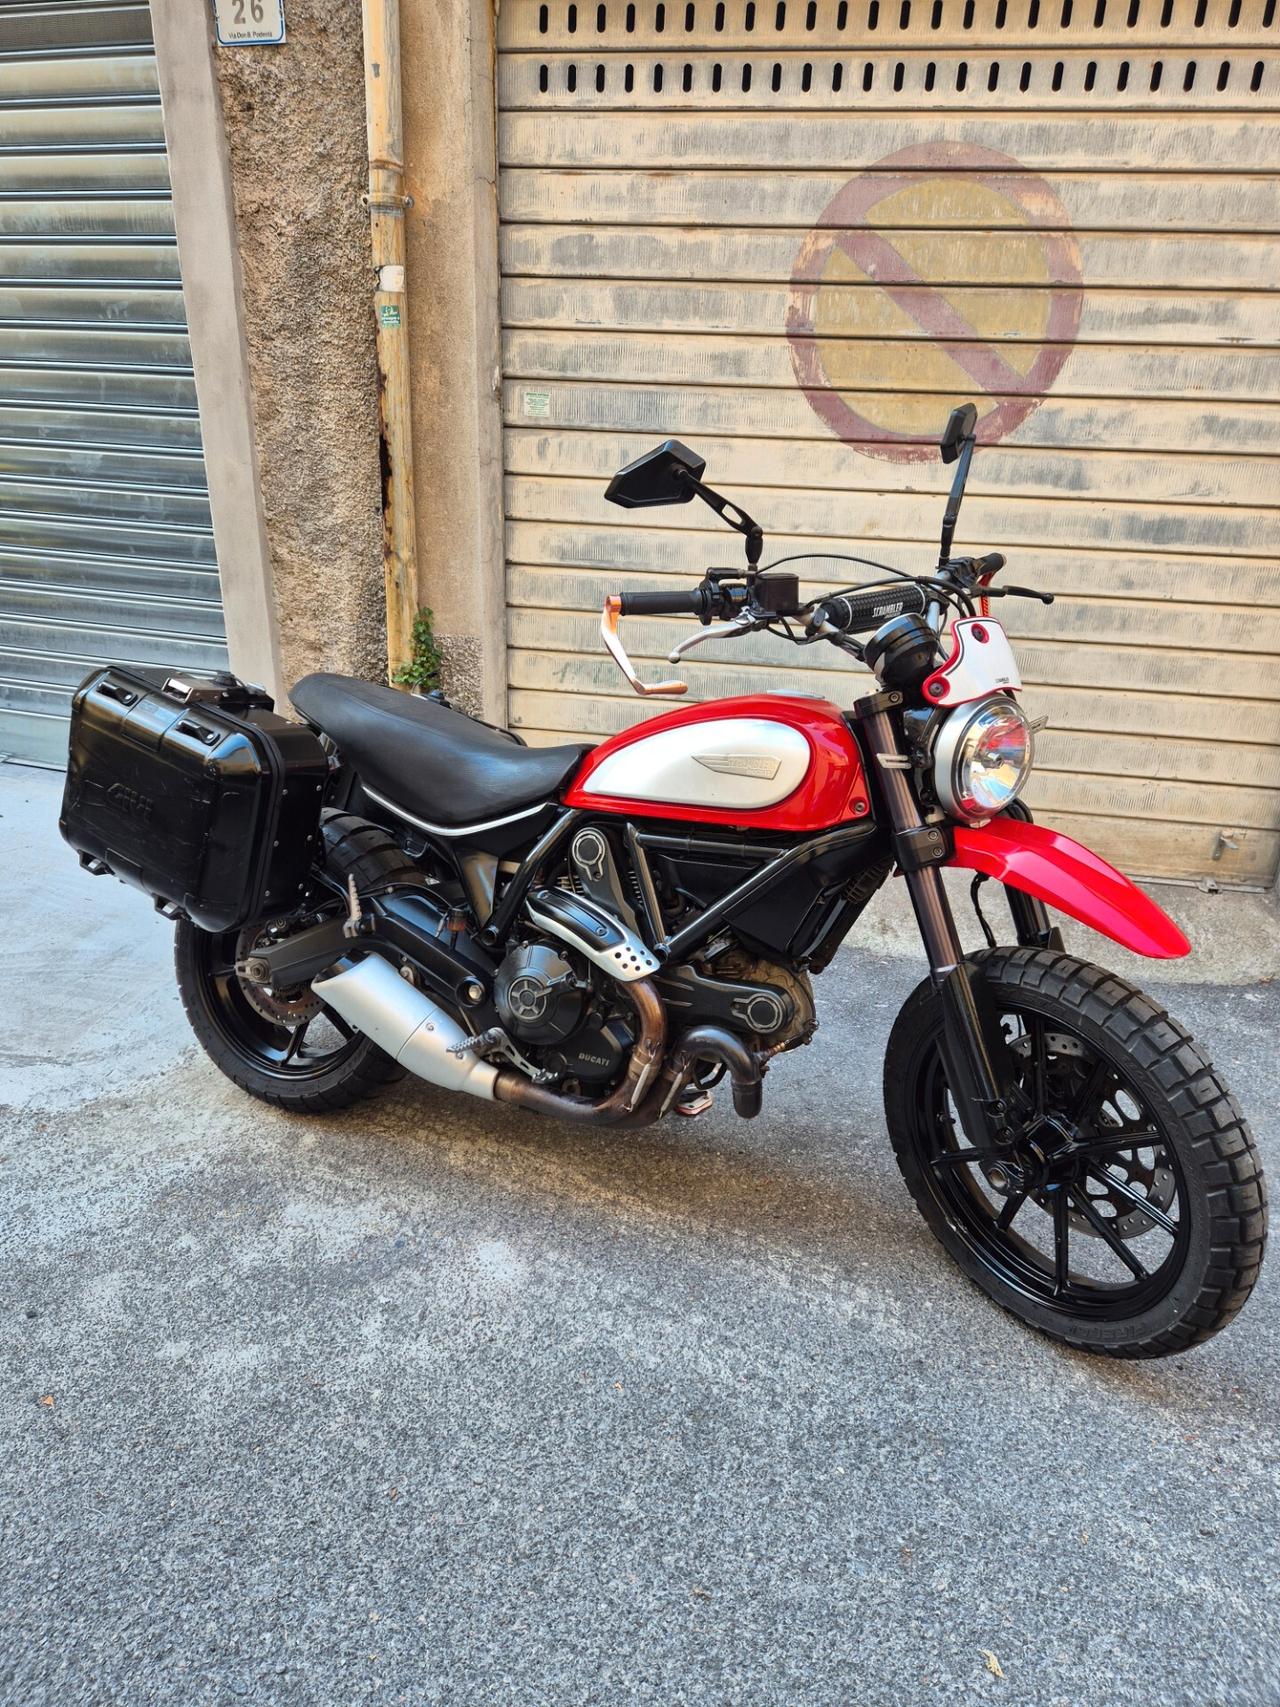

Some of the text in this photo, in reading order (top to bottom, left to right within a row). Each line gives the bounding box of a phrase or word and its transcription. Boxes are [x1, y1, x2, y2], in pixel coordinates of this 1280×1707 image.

[231, 0, 264, 24] 26
[871, 602, 904, 618] SCRAMBLER
[578, 1052, 611, 1067] DUCATI
